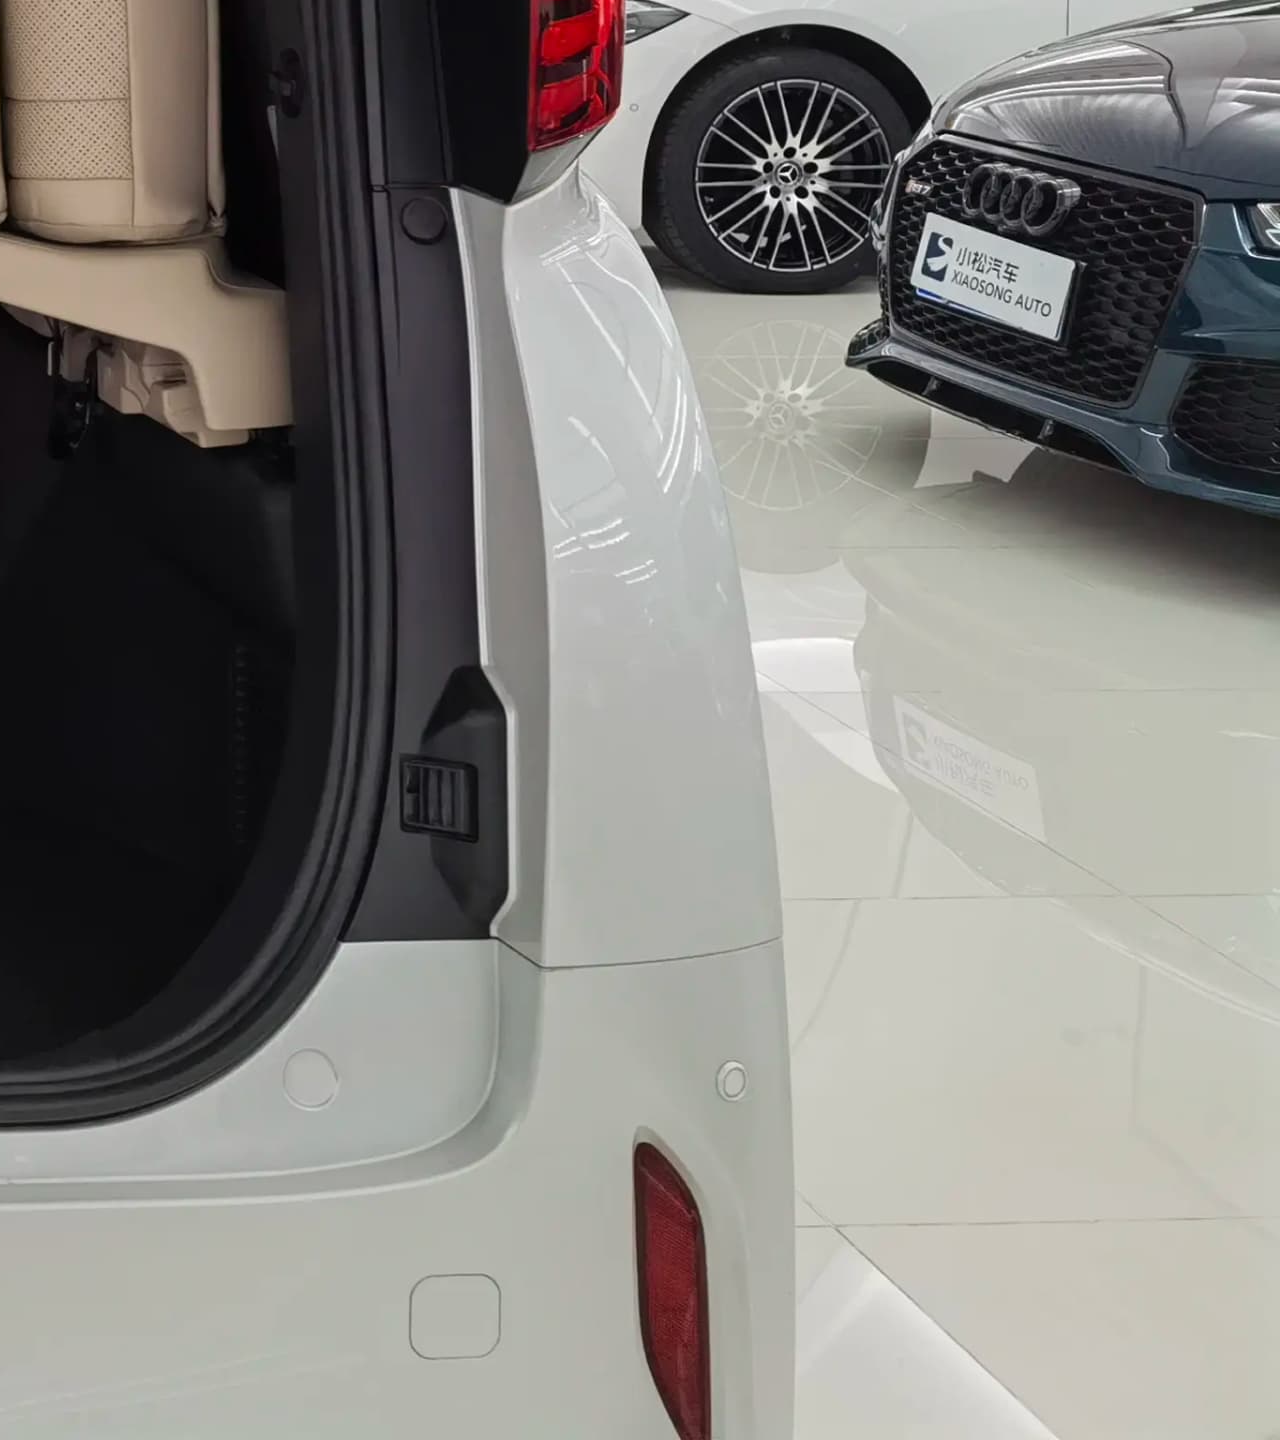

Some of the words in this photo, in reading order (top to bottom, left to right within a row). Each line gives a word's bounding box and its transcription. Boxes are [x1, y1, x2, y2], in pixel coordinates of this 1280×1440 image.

[955, 247, 1020, 284] 小松汽车
[951, 269, 1013, 304] XIAOSONG
[1015, 293, 1052, 318] AUTO
